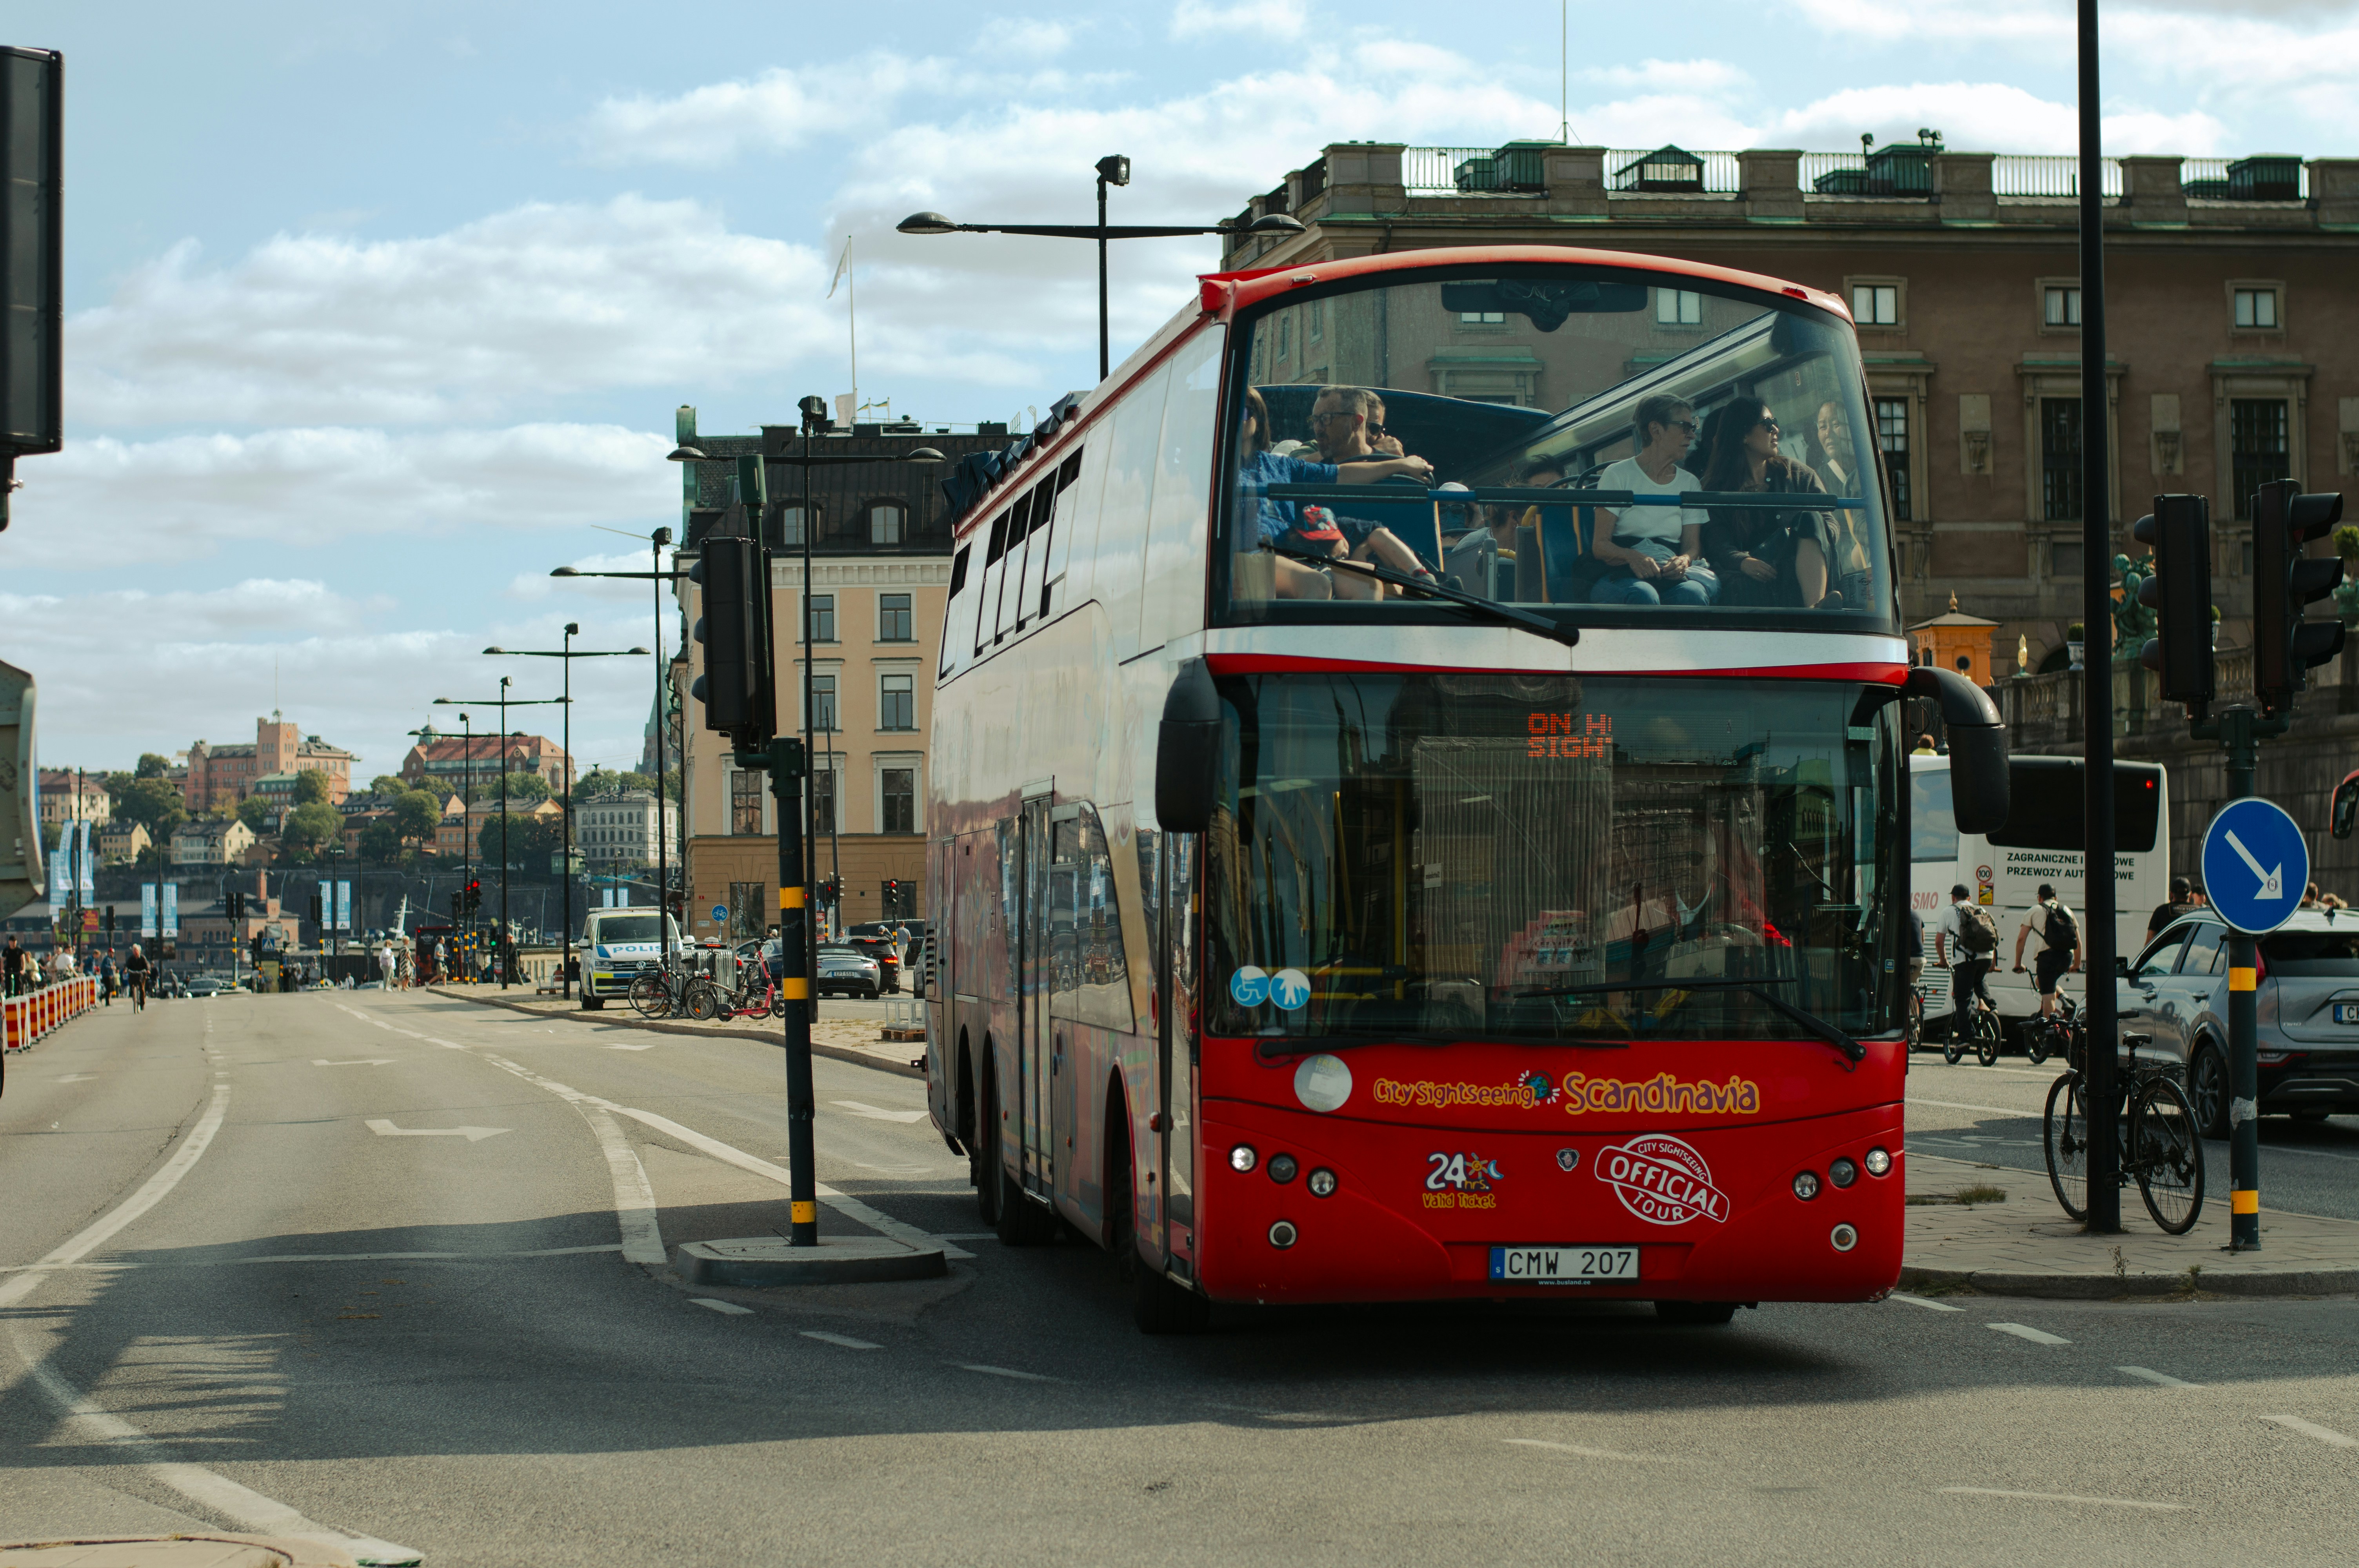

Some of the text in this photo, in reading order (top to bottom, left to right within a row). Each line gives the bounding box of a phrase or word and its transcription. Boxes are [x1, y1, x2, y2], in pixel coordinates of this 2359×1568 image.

[1528, 713, 1570, 734] ON
[1528, 737, 1611, 757] SIGH
[2007, 853, 2077, 864] ZAGRANICZNE
[2081, 856, 2083, 864] I
[2007, 866, 2062, 877] PRZEWOZY
[1911, 891, 1938, 909] SMO
[1374, 1071, 1760, 1115] City Sightseeing Scandinavia
[1426, 1152, 1467, 1190] 24
[1637, 1142, 1707, 1180] CITY SIGHTSEEING
[1610, 1156, 1719, 1217] OFFICIAL
[1422, 1192, 1497, 1209] Valid Ticket
[1633, 1191, 1685, 1220] TOUR
[1508, 1252, 1559, 1275] CMW
[1581, 1251, 1632, 1275] 207
